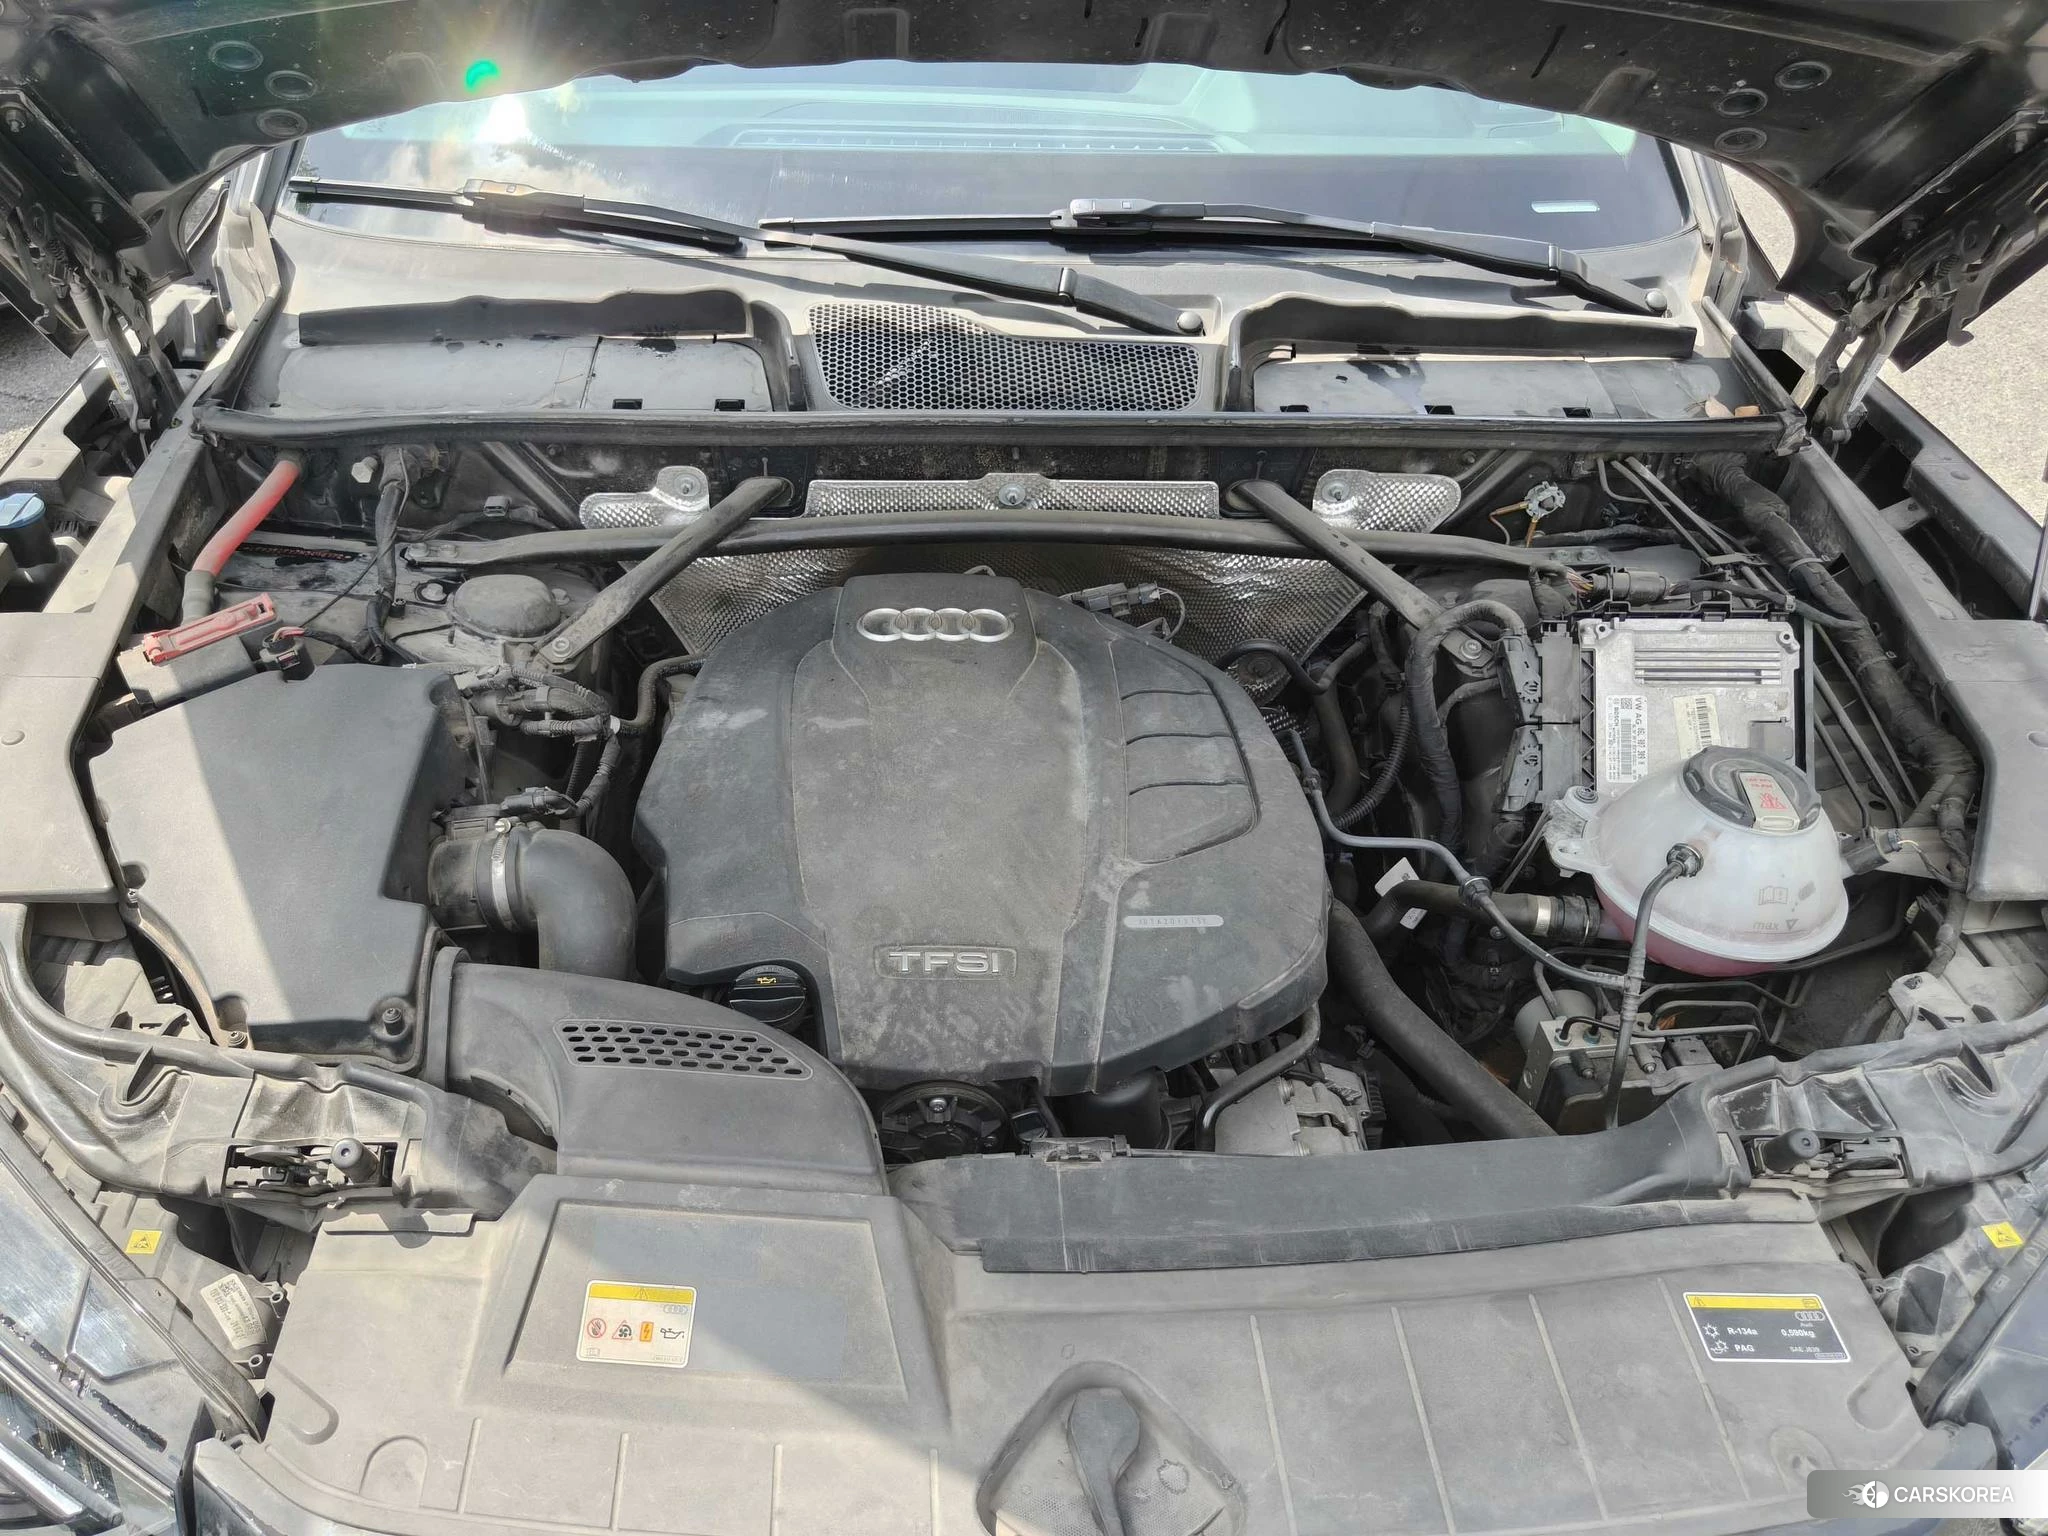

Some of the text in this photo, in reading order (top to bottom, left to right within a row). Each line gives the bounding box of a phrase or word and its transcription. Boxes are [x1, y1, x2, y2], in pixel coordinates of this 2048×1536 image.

[1634, 697, 1642, 711] VW
[1635, 713, 1642, 725] AG
[1753, 922, 1779, 931] max
[889, 952, 1000, 973] TFSI
[1727, 1327, 1759, 1336] R-134a
[1734, 1344, 1755, 1353] PAG
